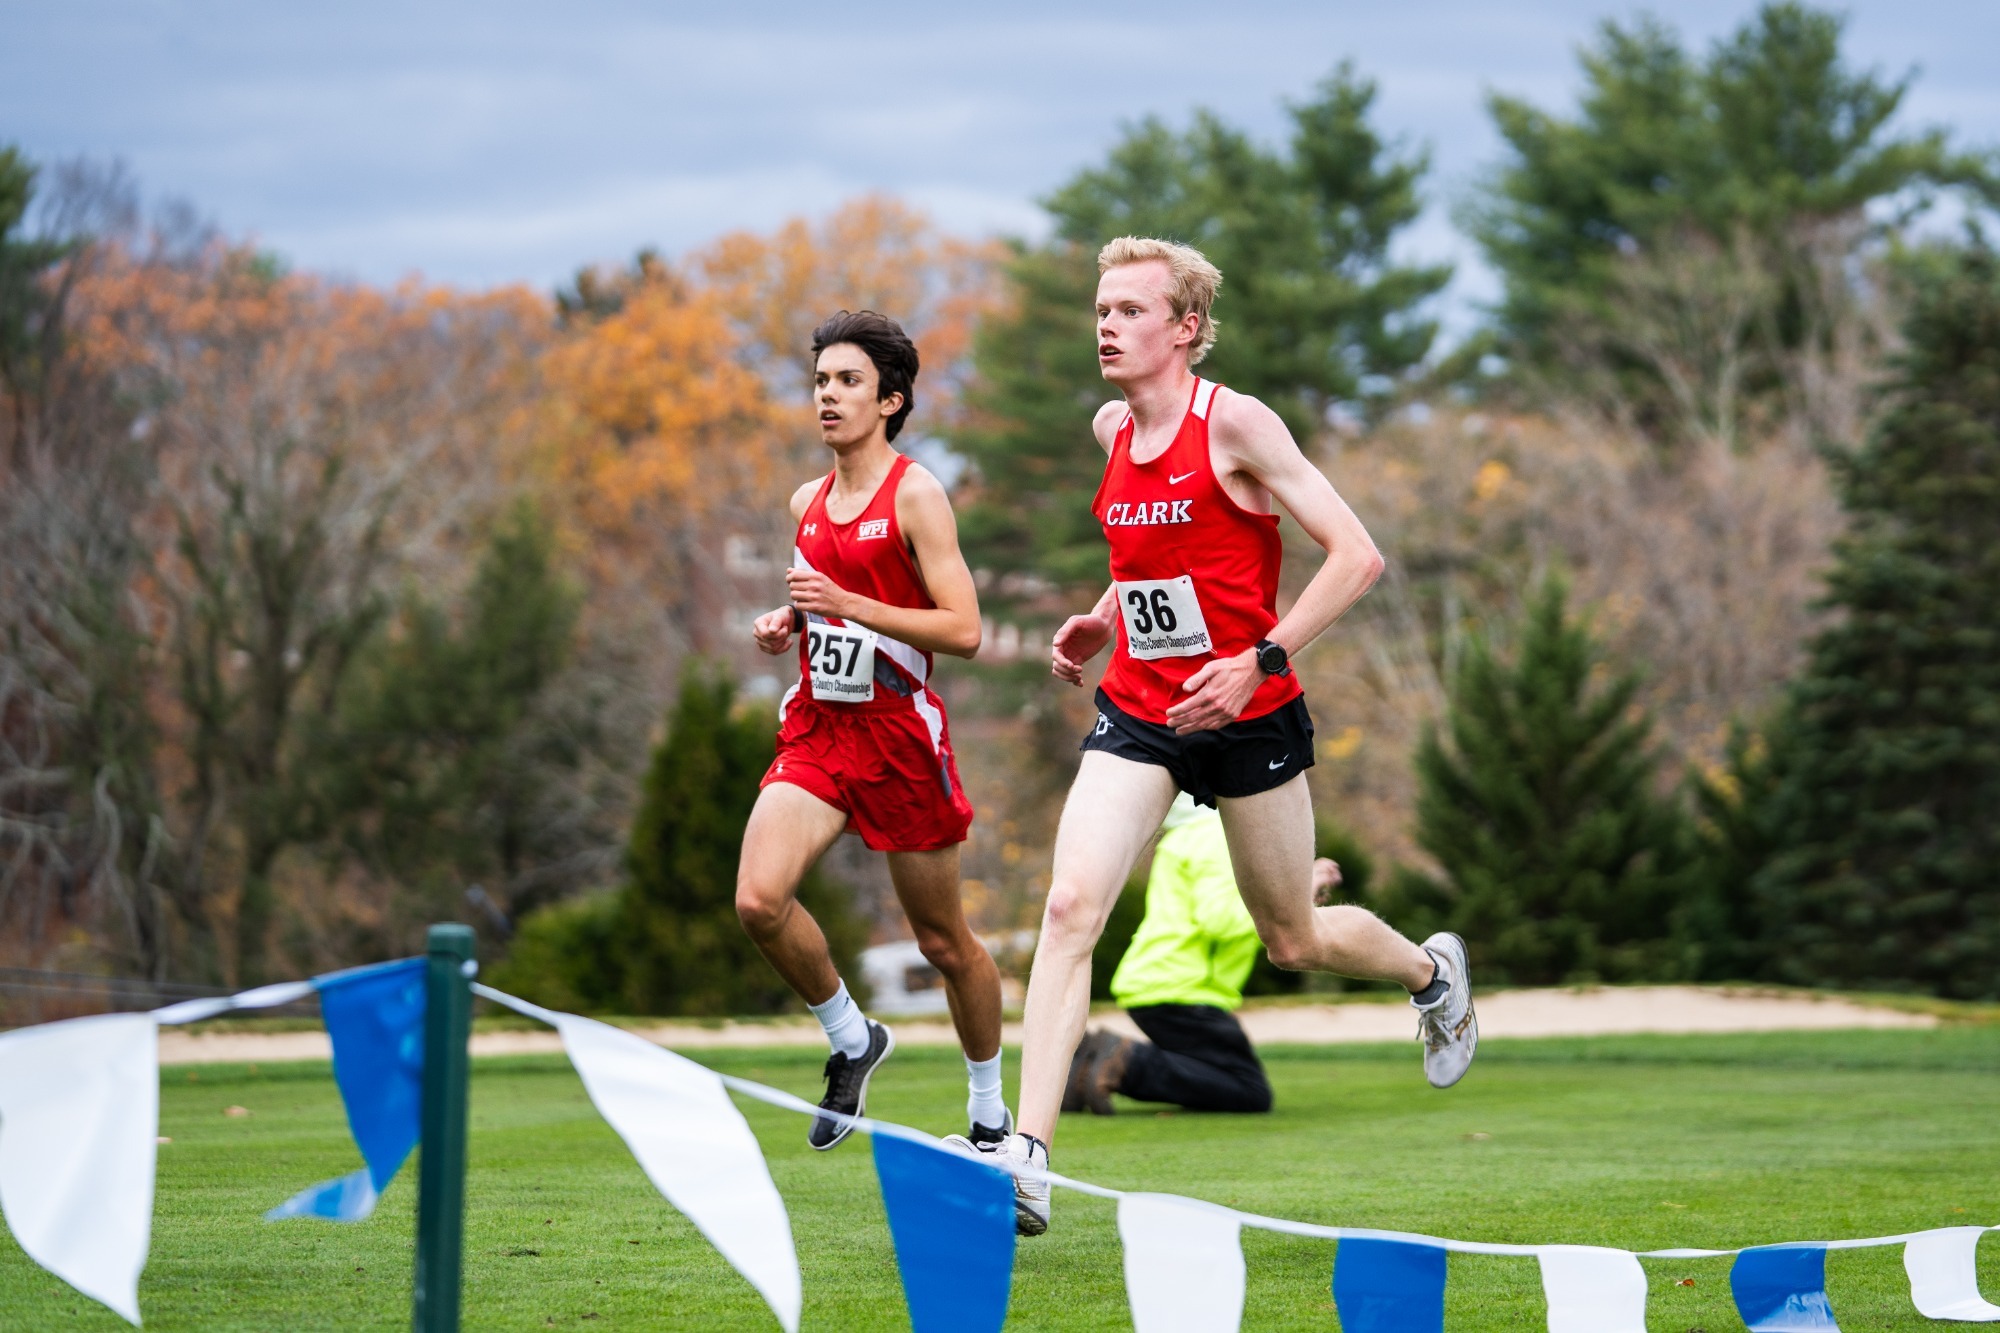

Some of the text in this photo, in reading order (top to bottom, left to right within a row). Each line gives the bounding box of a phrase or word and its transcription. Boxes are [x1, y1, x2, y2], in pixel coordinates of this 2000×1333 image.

[1106, 499, 1193, 526] CLARK
[859, 522, 888, 537] WPI
[1128, 589, 1177, 635] 36
[1166, 631, 1207, 649] Championships
[808, 631, 863, 677] 257
[835, 679, 871, 695] Championships
